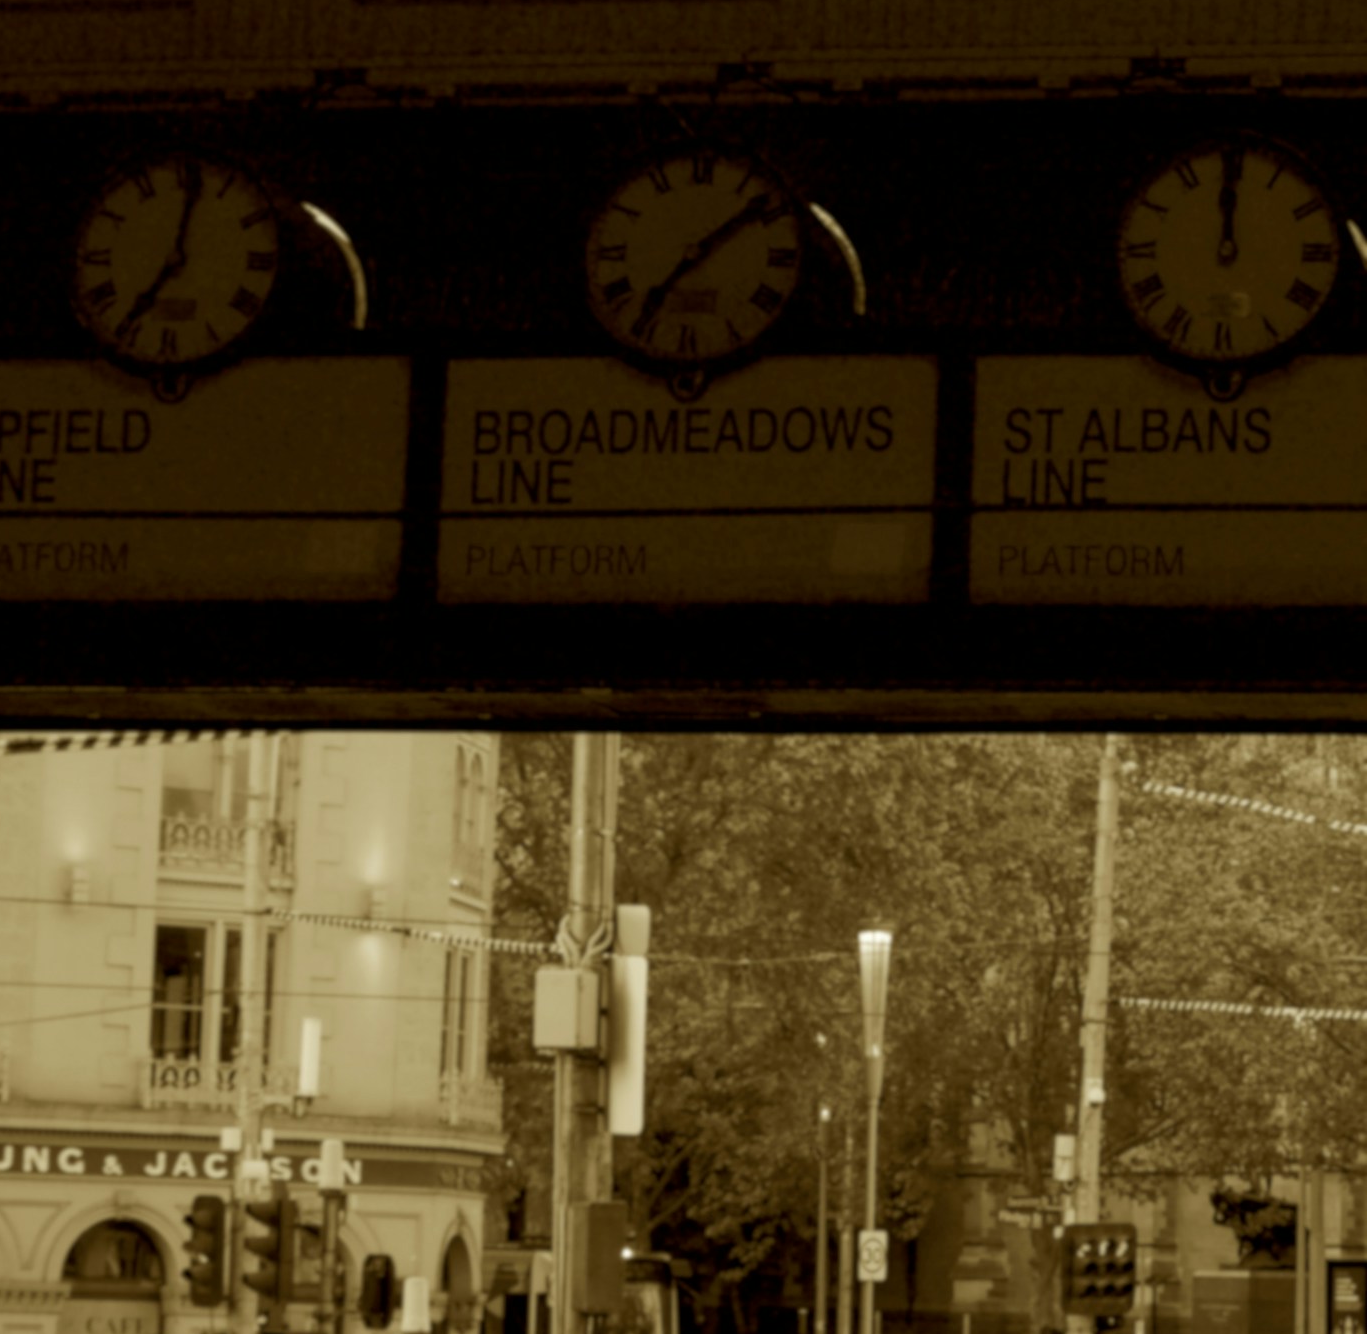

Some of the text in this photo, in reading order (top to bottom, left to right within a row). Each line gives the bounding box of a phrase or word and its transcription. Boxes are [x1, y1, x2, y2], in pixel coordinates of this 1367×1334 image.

[472, 404, 896, 456] BROADMEADOWS
[1001, 406, 1274, 455] ST ALBANS
[469, 458, 576, 506] LINE
[1001, 457, 1110, 506] LINE
[464, 542, 648, 577] PLATFORM
[996, 543, 1186, 578] PLATFORM
[102, 1155, 123, 1176] &
[144, 1150, 362, 1185] JACSON
